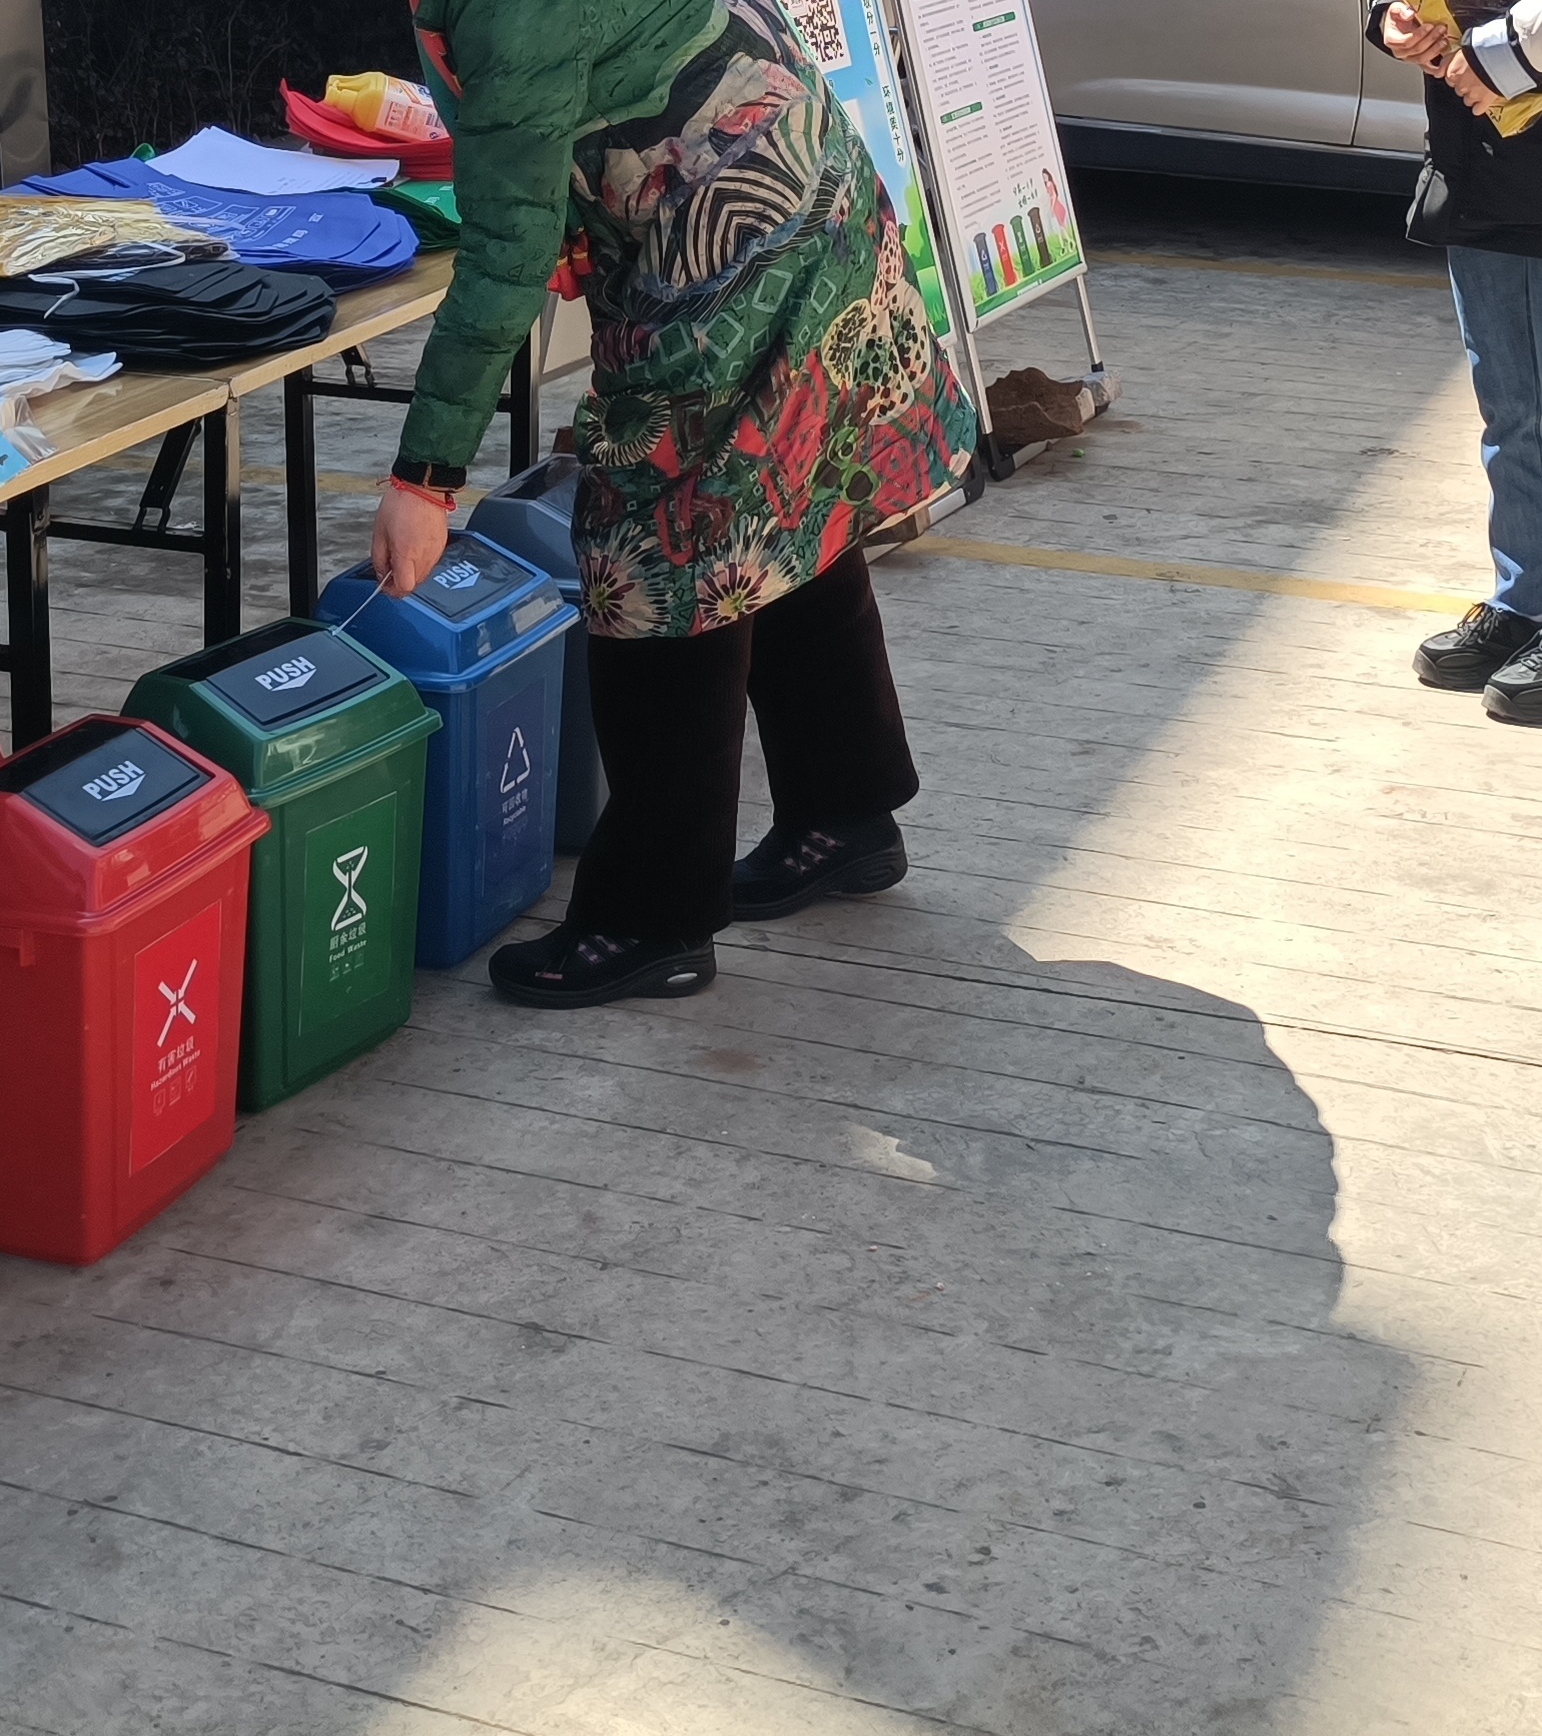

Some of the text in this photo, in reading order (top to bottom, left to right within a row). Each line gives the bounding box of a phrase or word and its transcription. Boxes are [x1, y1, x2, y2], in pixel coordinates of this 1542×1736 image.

[882, 86, 904, 162] 环境美十分
[433, 560, 480, 589] PUSH
[254, 656, 316, 690] PUSH
[81, 760, 145, 800] PUSH
[329, 922, 366, 951] 厨余垃圾
[329, 940, 367, 963] Food Waste
[157, 1035, 194, 1075] 有害垃圾
[182, 1049, 201, 1068] Waste
